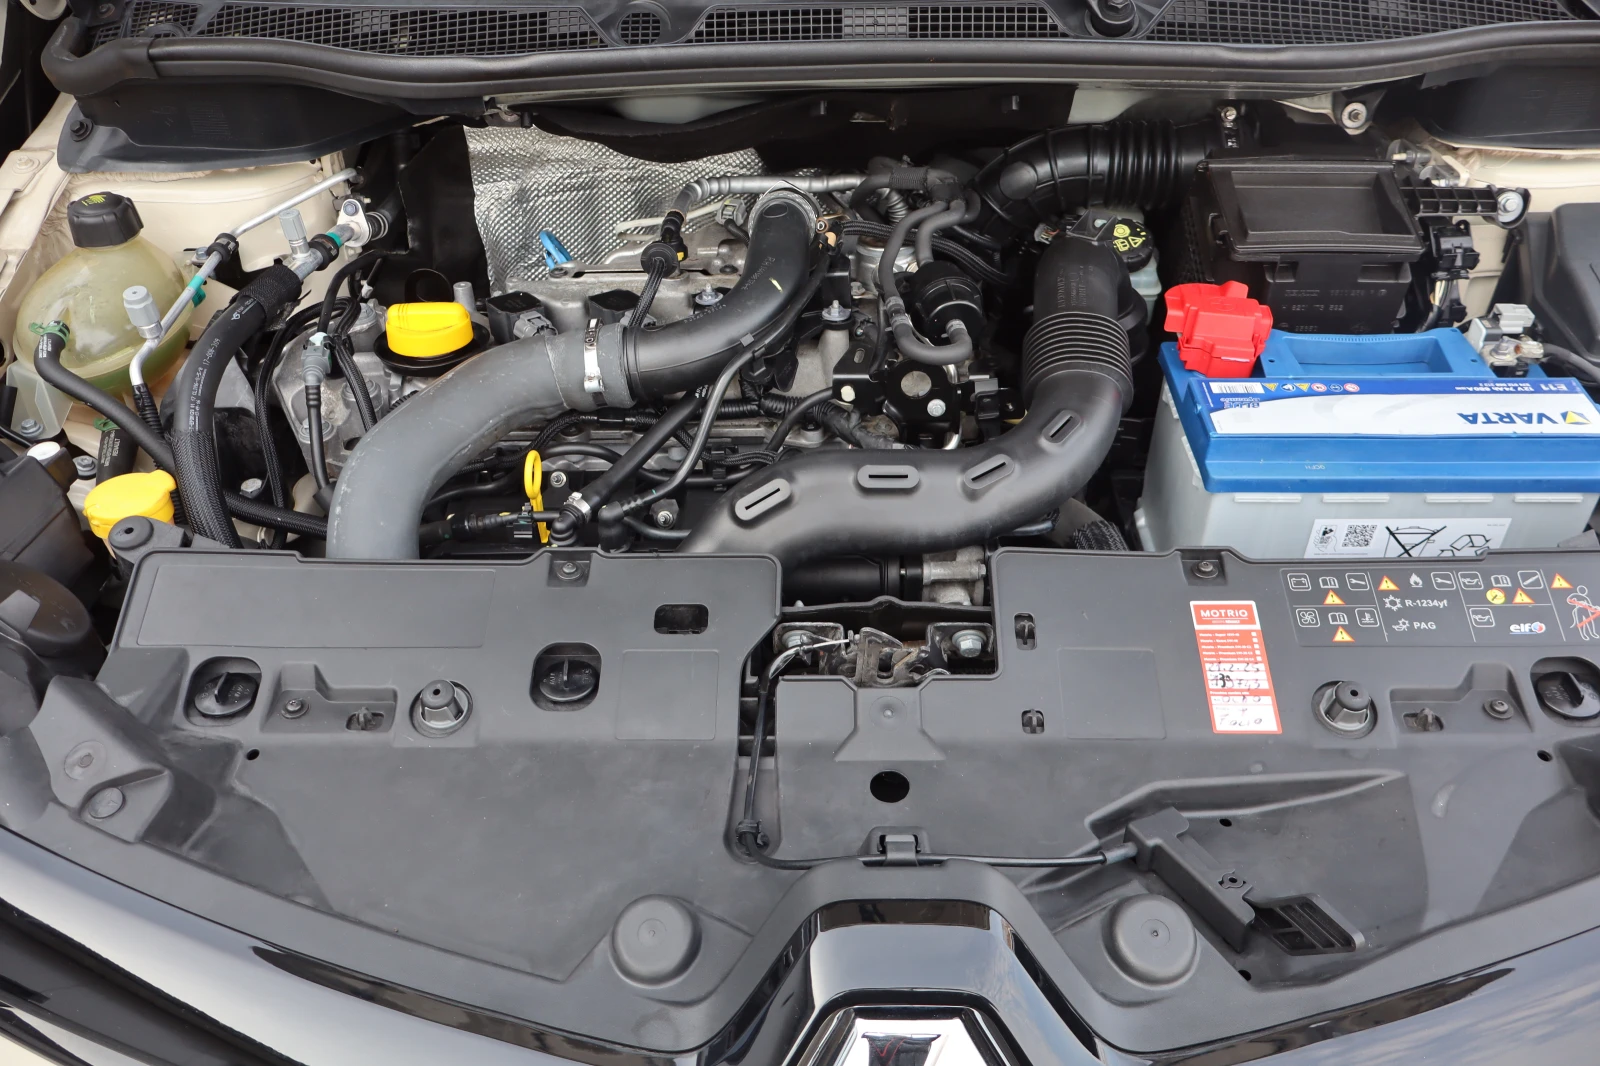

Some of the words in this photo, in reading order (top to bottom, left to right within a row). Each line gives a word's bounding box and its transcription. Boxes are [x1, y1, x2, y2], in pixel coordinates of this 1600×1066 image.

[1540, 383, 1569, 391] E11
[1223, 400, 1260, 408] BLUE
[1457, 412, 1559, 424] VARTA
[1404, 600, 1448, 608] R-1234yf
[1200, 609, 1248, 618] MOTRIO
[1413, 621, 1437, 630] PAG
[1510, 623, 1532, 633] elf
